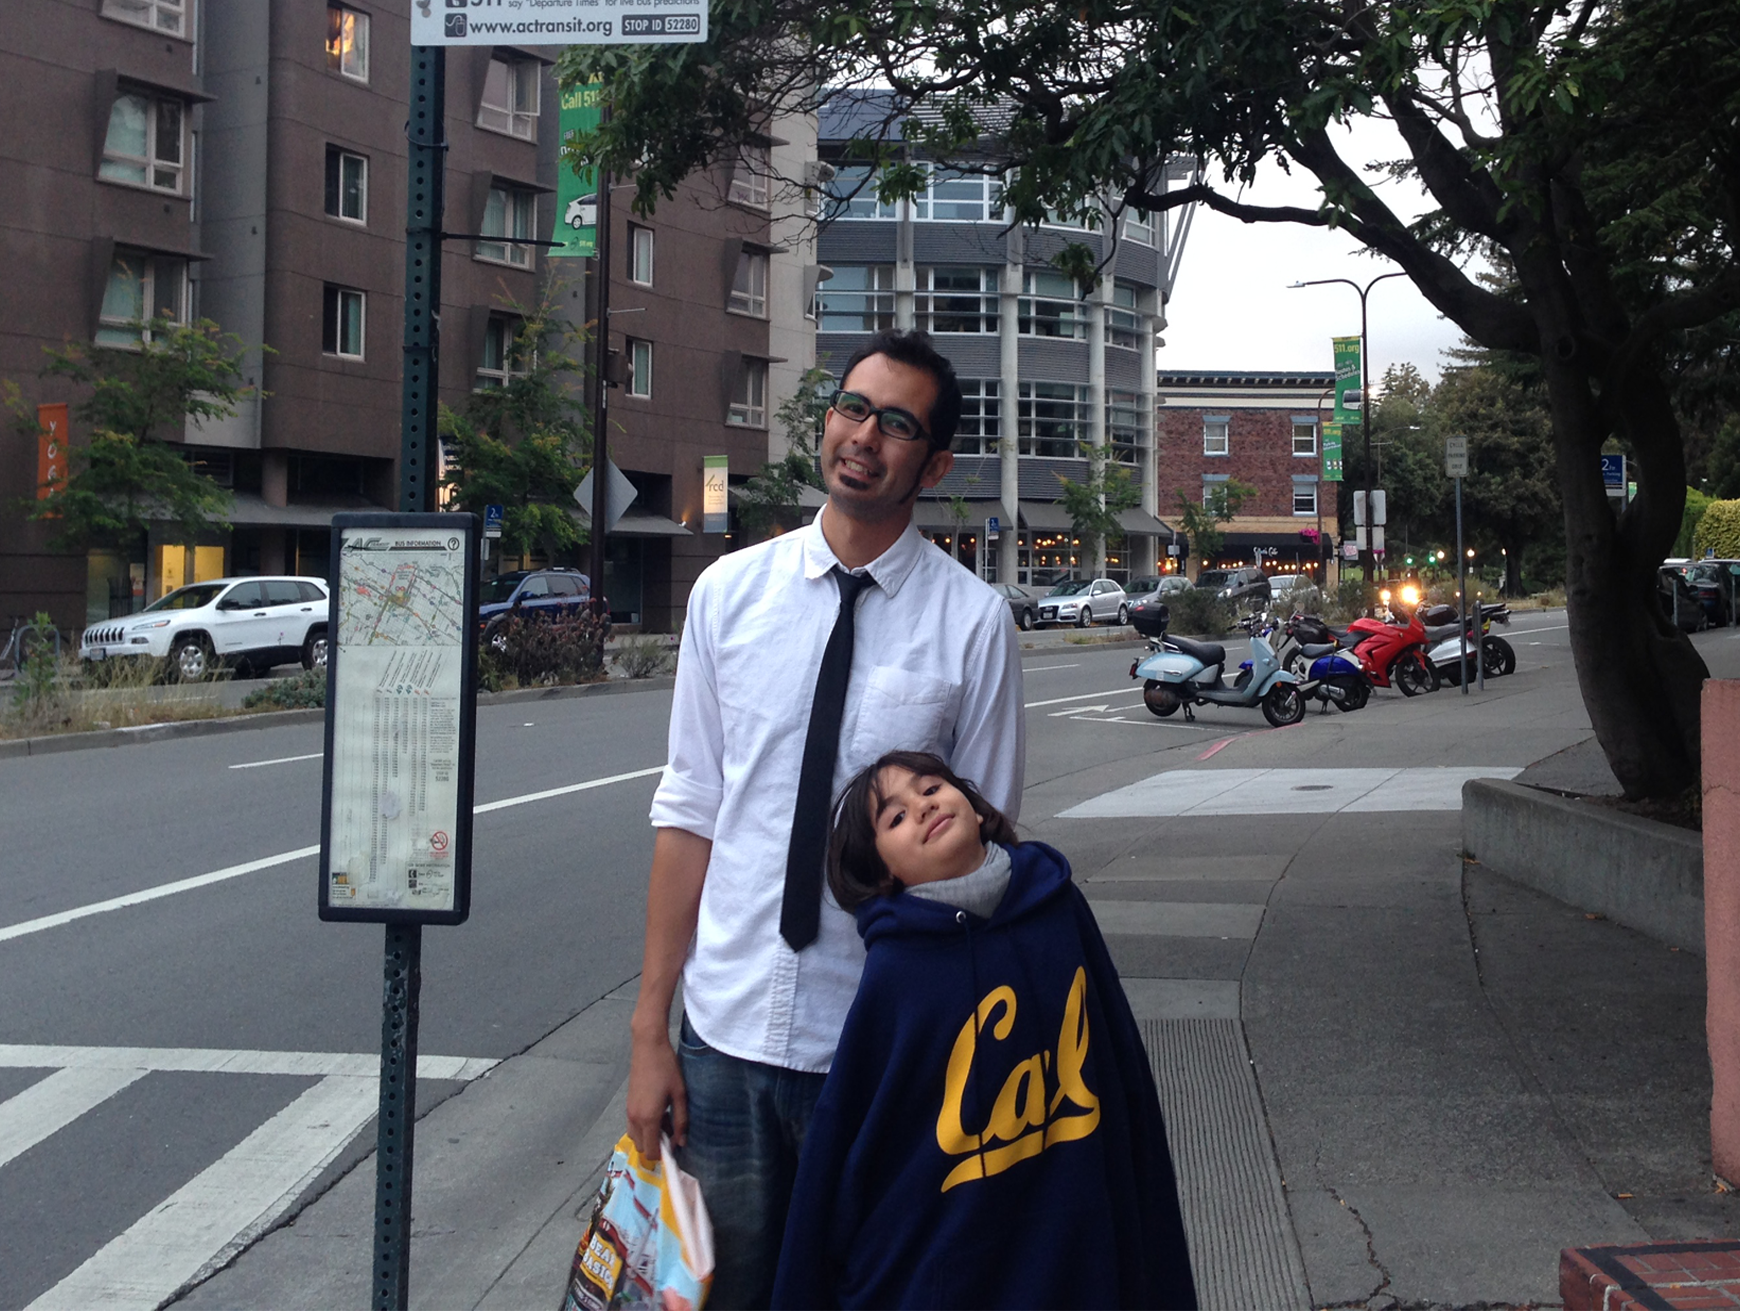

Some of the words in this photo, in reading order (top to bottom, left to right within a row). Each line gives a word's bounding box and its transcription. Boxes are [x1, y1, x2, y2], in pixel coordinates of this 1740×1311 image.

[508, 0, 522, 9] say
[469, 16, 613, 37] www.actransit.org
[624, 19, 649, 31] STOP
[651, 19, 662, 31] ID
[667, 18, 697, 31] 52280
[561, 91, 582, 110] Call
[1334, 343, 1360, 354] 511.org
[1601, 458, 1609, 471] 2
[708, 480, 724, 492] rcd
[936, 966, 1100, 1193] Cal
